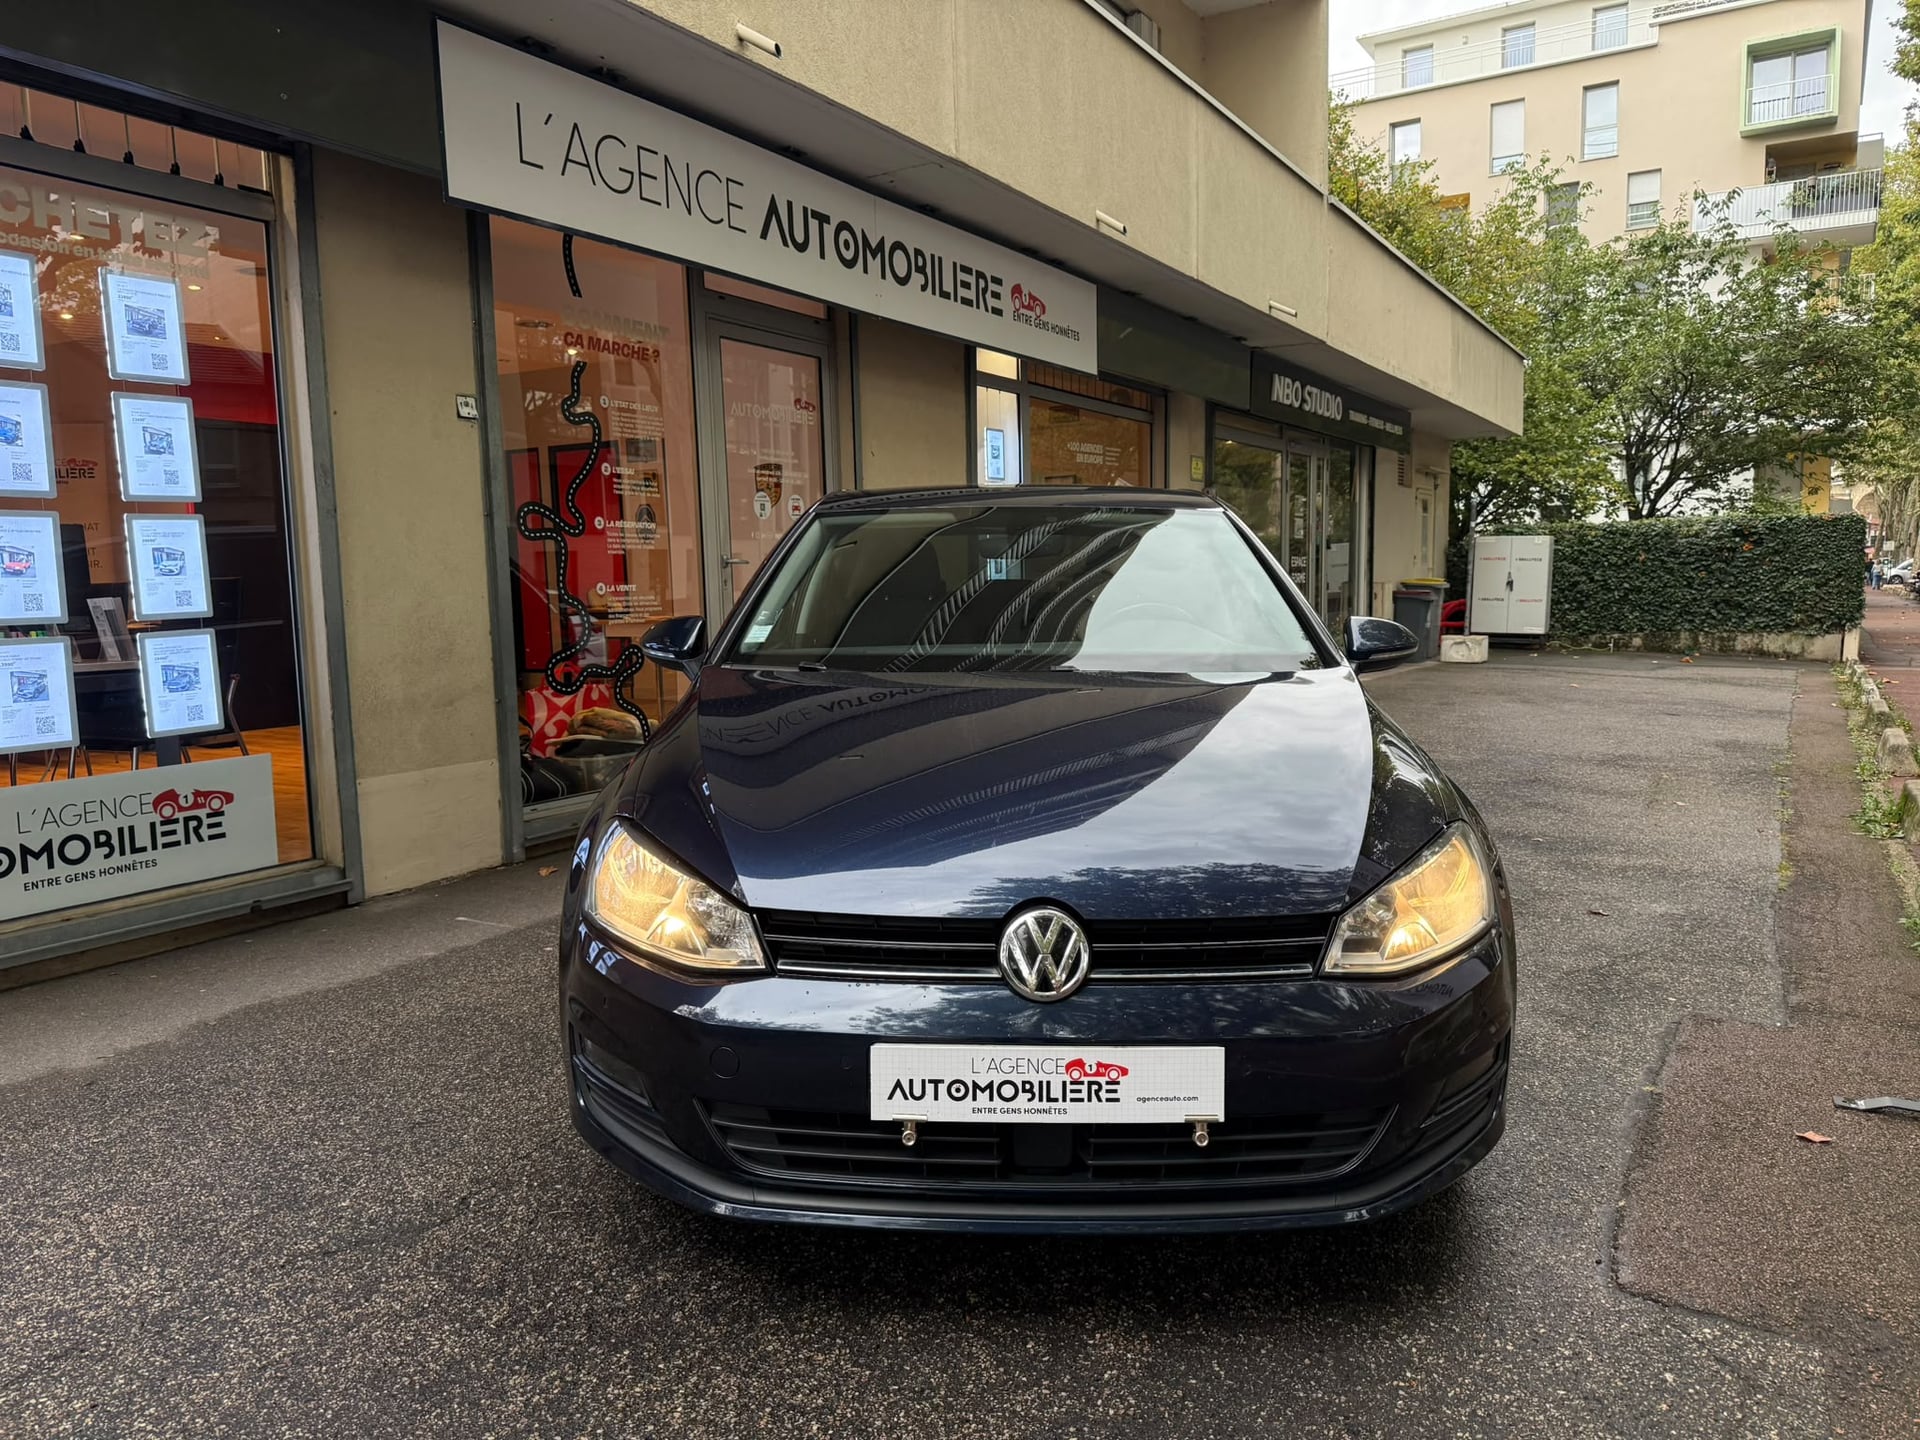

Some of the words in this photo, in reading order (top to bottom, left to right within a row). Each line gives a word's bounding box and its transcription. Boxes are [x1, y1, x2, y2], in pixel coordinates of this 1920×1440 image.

[516, 102, 747, 233] L'AGENCE
[760, 194, 1004, 318] AUTOMOBILIERE
[1013, 311, 1033, 327] ENTRE
[1034, 318, 1050, 332] GENS
[588, 336, 651, 362] MARCHE
[652, 350, 660, 363] ?
[1271, 373, 1302, 408] NBO
[1302, 384, 1343, 420] STUDIO
[606, 520, 615, 528] LA
[16, 792, 154, 835] L'AGENCE
[23, 876, 62, 892] ENTRE
[65, 871, 96, 885] GENS
[99, 858, 158, 877] HONNÊTES
[971, 1057, 1066, 1075] L'AGENCE
[887, 1078, 1121, 1103] AUTOMOBILIERE
[1136, 1095, 1199, 1104] agenceauto.com
[1023, 1106, 1068, 1115] HONNÊTES
